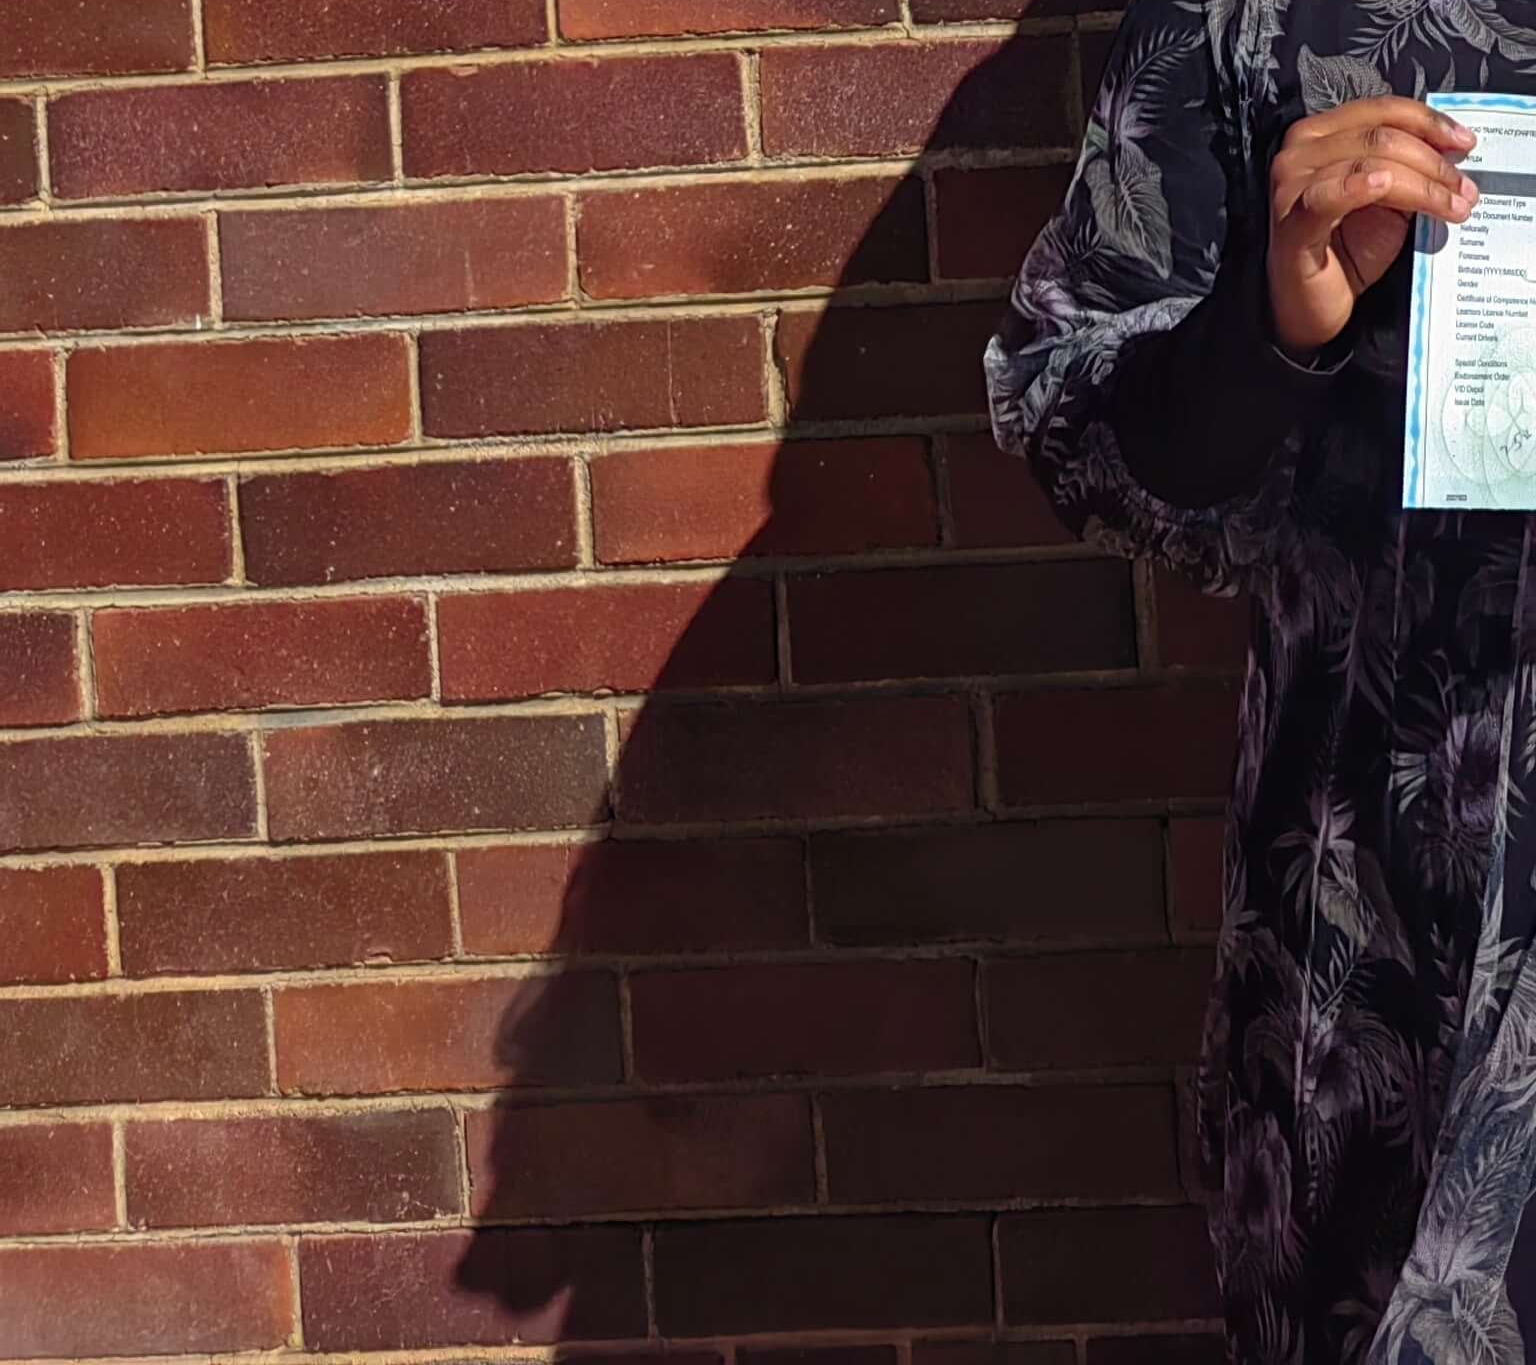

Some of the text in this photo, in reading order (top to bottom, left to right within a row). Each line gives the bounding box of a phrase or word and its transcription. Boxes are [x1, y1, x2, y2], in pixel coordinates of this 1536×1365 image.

[1484, 197, 1512, 207] Document
[1513, 199, 1526, 209] Type
[1483, 211, 1510, 221] Document
[1512, 213, 1533, 222] Number
[1456, 294, 1485, 303] Certificate
